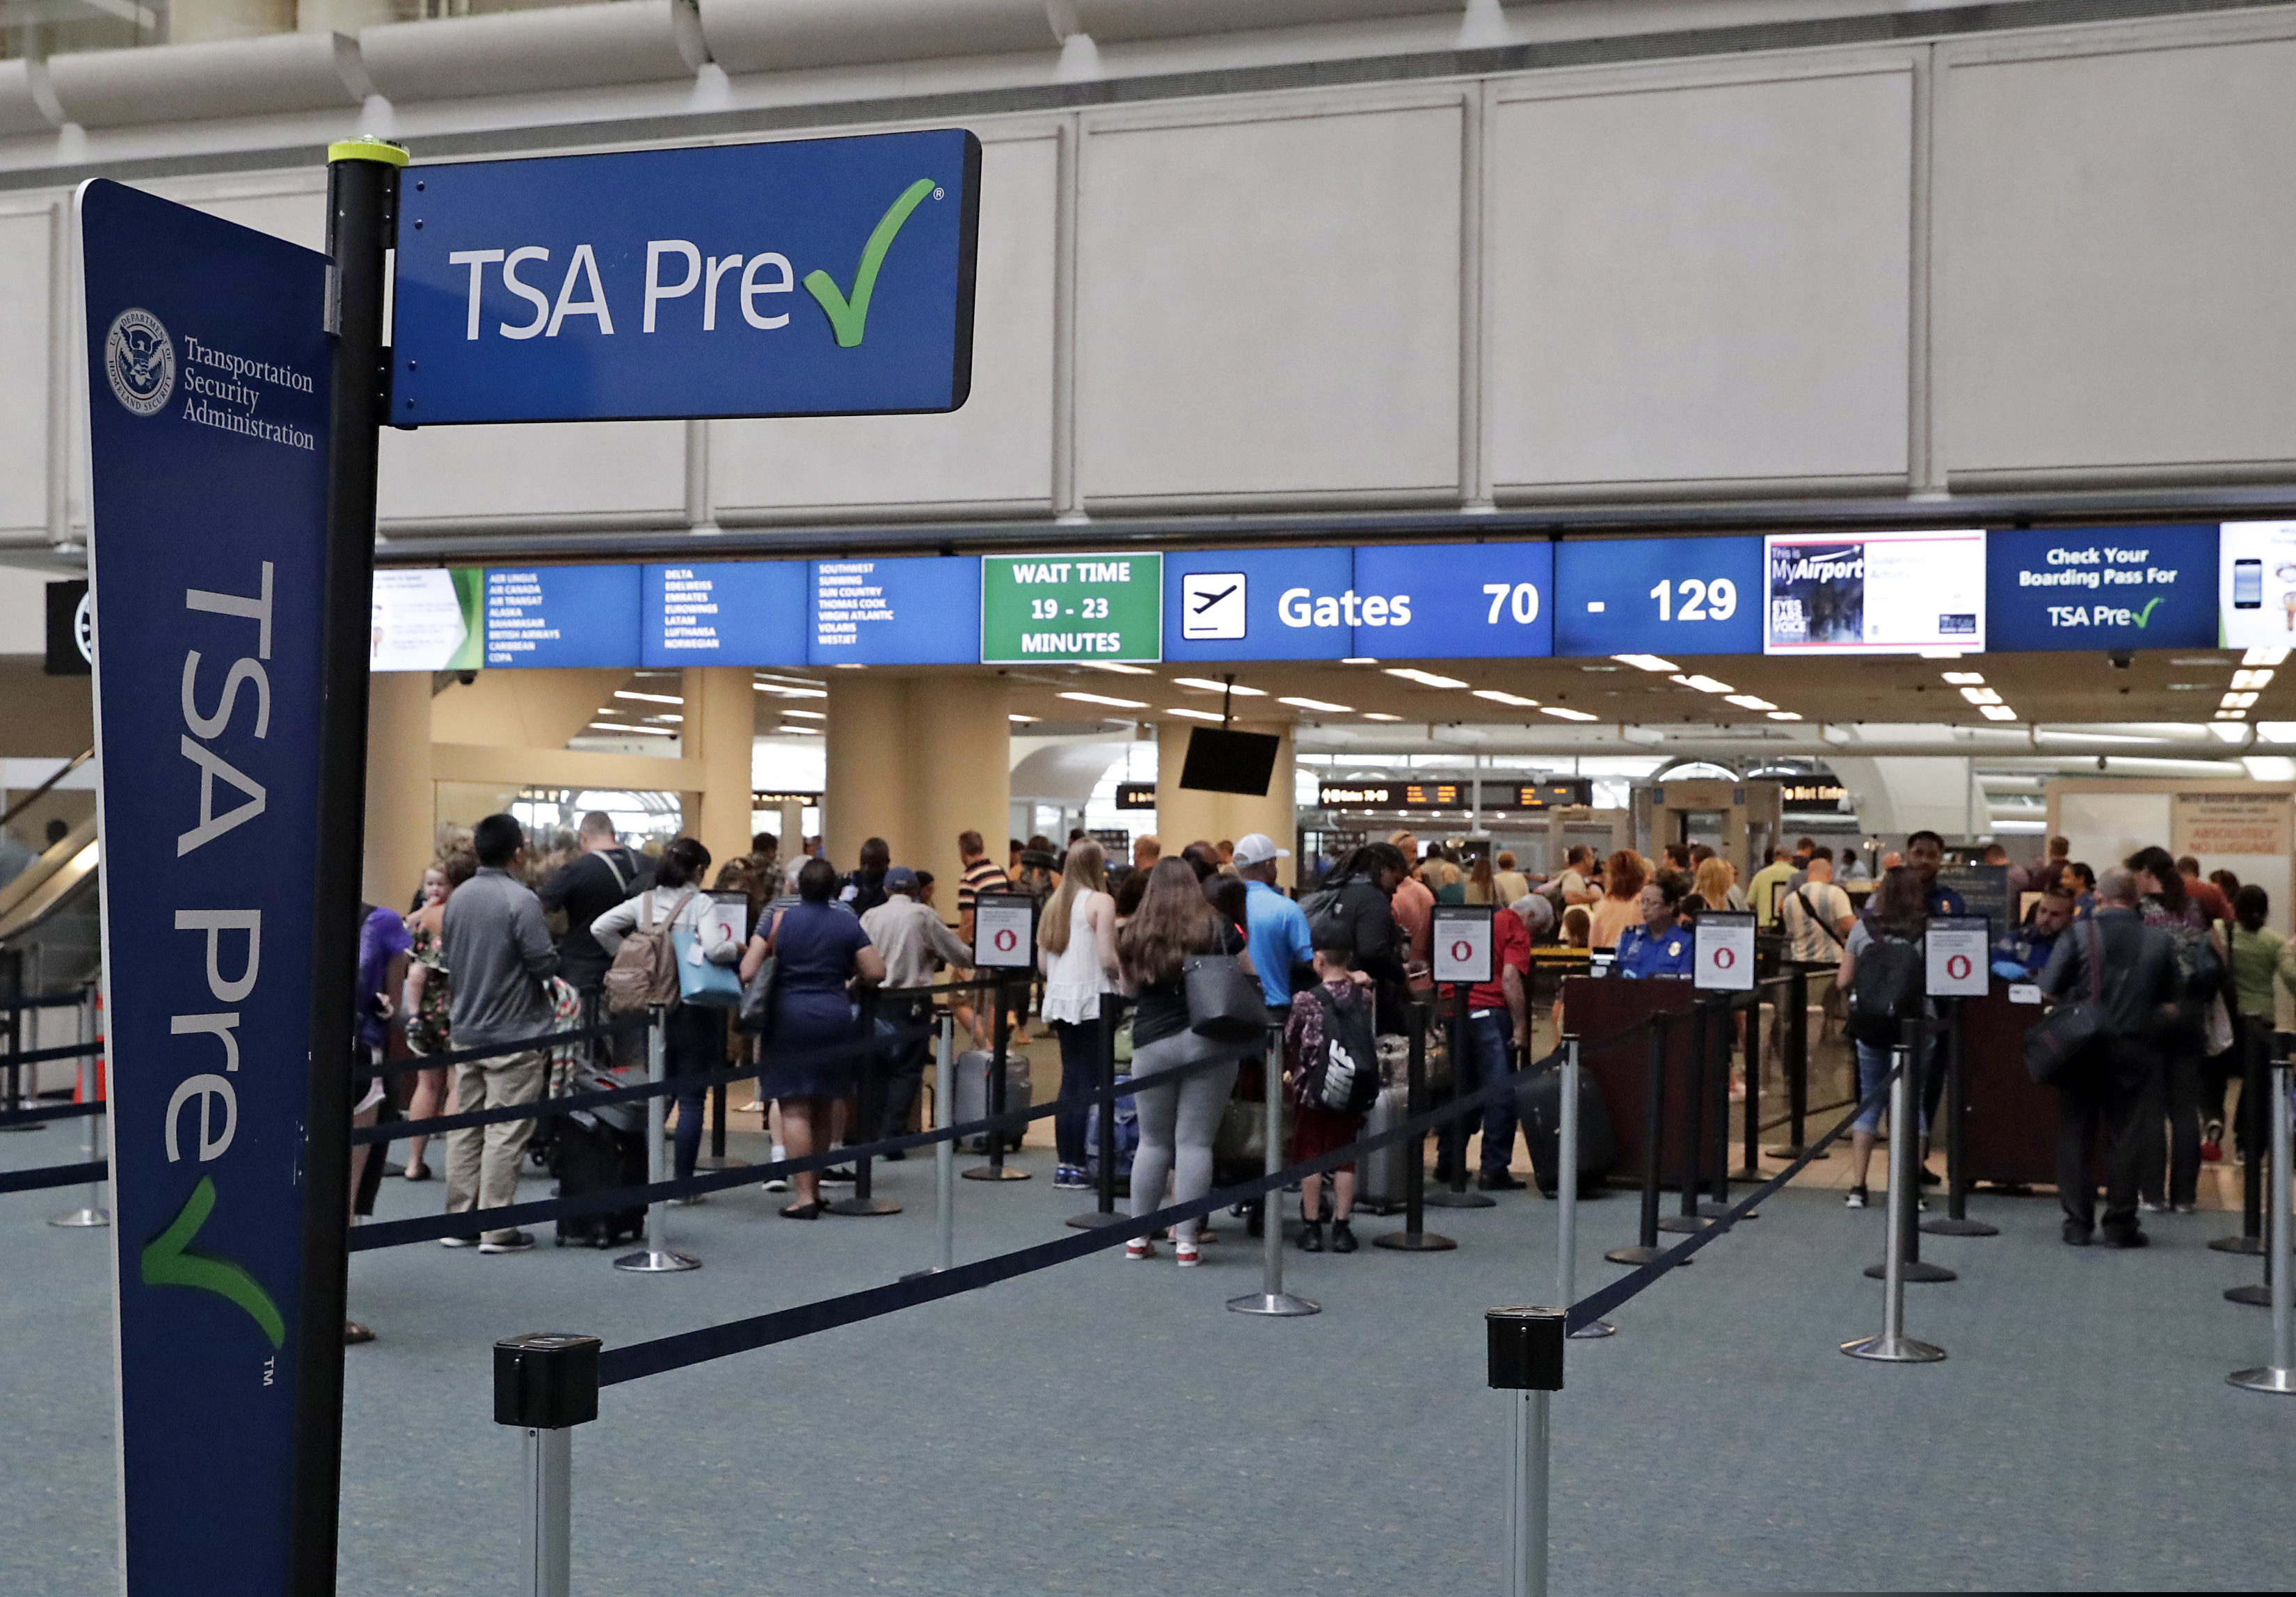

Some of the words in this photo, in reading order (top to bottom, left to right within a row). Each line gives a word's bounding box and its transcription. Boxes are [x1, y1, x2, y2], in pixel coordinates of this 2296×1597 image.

[449, 244, 614, 341] TSA
[642, 239, 794, 333] Pre
[120, 313, 168, 345] DEPARTMENT
[165, 348, 173, 363] OF
[184, 335, 313, 392] Transportation
[109, 360, 141, 409] HOMELAND
[144, 376, 172, 411] SECURITY
[184, 367, 260, 413] Security
[182, 397, 314, 450] Administration
[2046, 547, 2101, 565] Check
[2103, 547, 2150, 564] Your
[664, 569, 694, 580] DELTA
[819, 563, 875, 574] SOUTHWEST
[1012, 563, 1072, 584] WAIT
[1076, 562, 1131, 583] TIME
[2019, 568, 2100, 589] Boarding
[2103, 568, 2144, 585] Pass
[2146, 566, 2178, 585] For
[488, 585, 504, 596] AIR
[504, 584, 542, 595] CANADA
[664, 591, 709, 603] EMIRATES
[818, 587, 838, 598] SUN
[838, 586, 883, 598] COUNTRY
[488, 596, 504, 607] AIR
[818, 598, 859, 610] THOMAS
[859, 598, 887, 609] COOK
[1031, 598, 1058, 619] 19
[1081, 597, 1109, 619] 23
[1278, 587, 1412, 628] Gates
[1483, 582, 1540, 625] 70
[1650, 578, 1737, 621] 129
[488, 607, 523, 618] ALASKA
[850, 610, 895, 621] ATLANTIC
[2047, 605, 2091, 627] TSA
[2094, 605, 2132, 626] Pre
[664, 615, 697, 626] LATAM
[818, 622, 857, 633] VOLARIS
[520, 628, 561, 639] AIRWAYS
[818, 634, 858, 645] WESTJET
[664, 638, 720, 649] NORWEGIAN
[1021, 632, 1122, 653] MINUTES
[488, 653, 513, 663] COPA
[176, 562, 274, 859] TSA
[165, 909, 262, 1164] Pre
